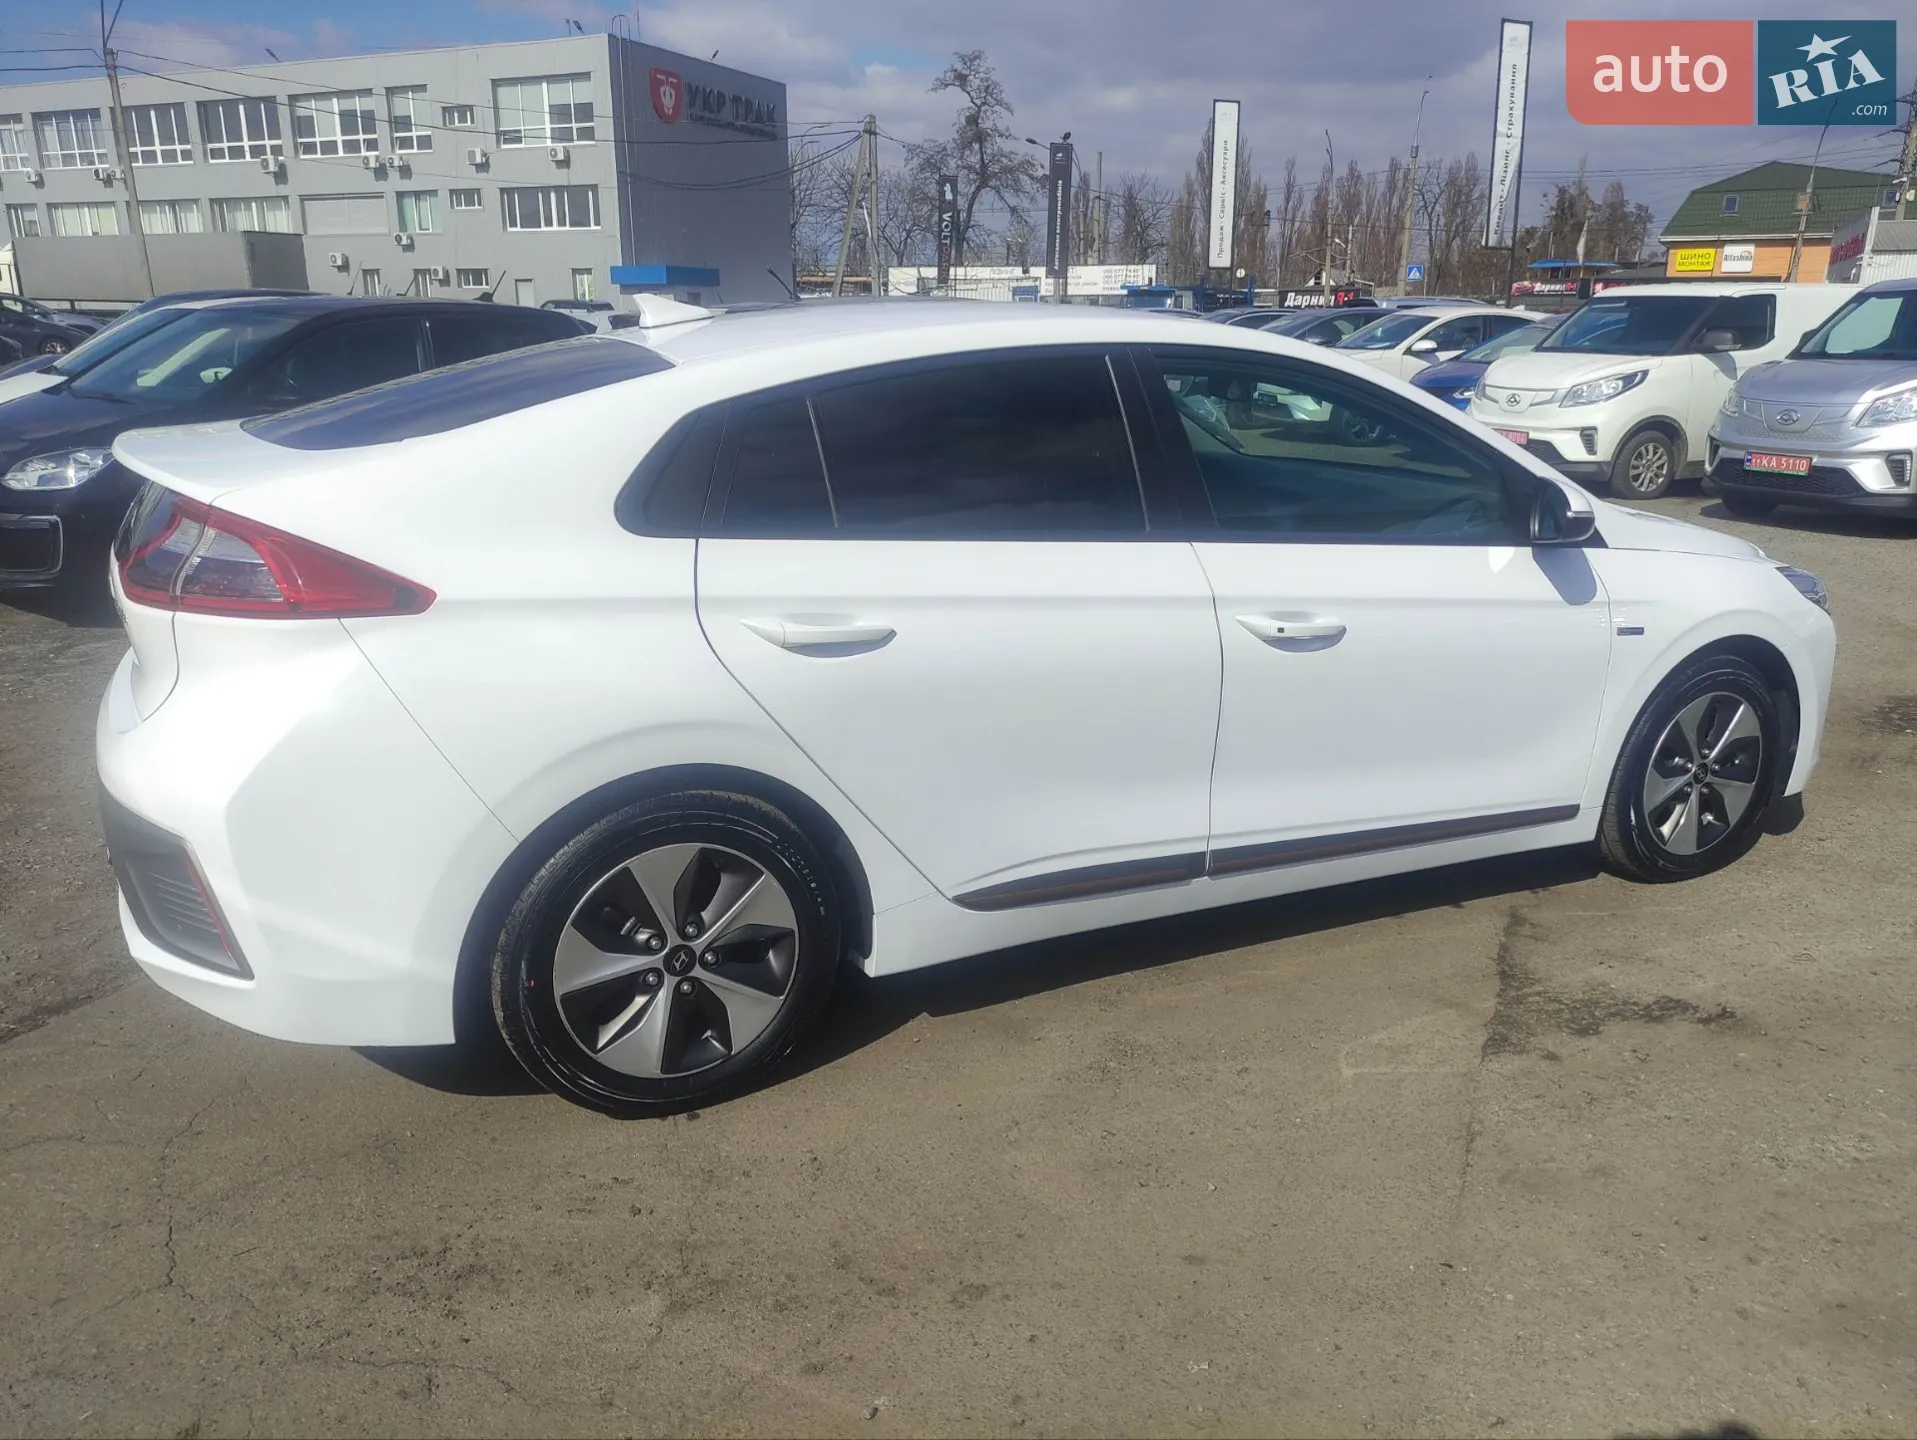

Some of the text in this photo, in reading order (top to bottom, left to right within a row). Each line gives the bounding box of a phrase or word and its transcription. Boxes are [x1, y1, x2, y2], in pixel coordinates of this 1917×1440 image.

[1216, 140, 1229, 259] Продаж Сервіс Аксесуари
[1680, 252, 1711, 260] ШИНО
[1780, 457, 1807, 471] 5110
